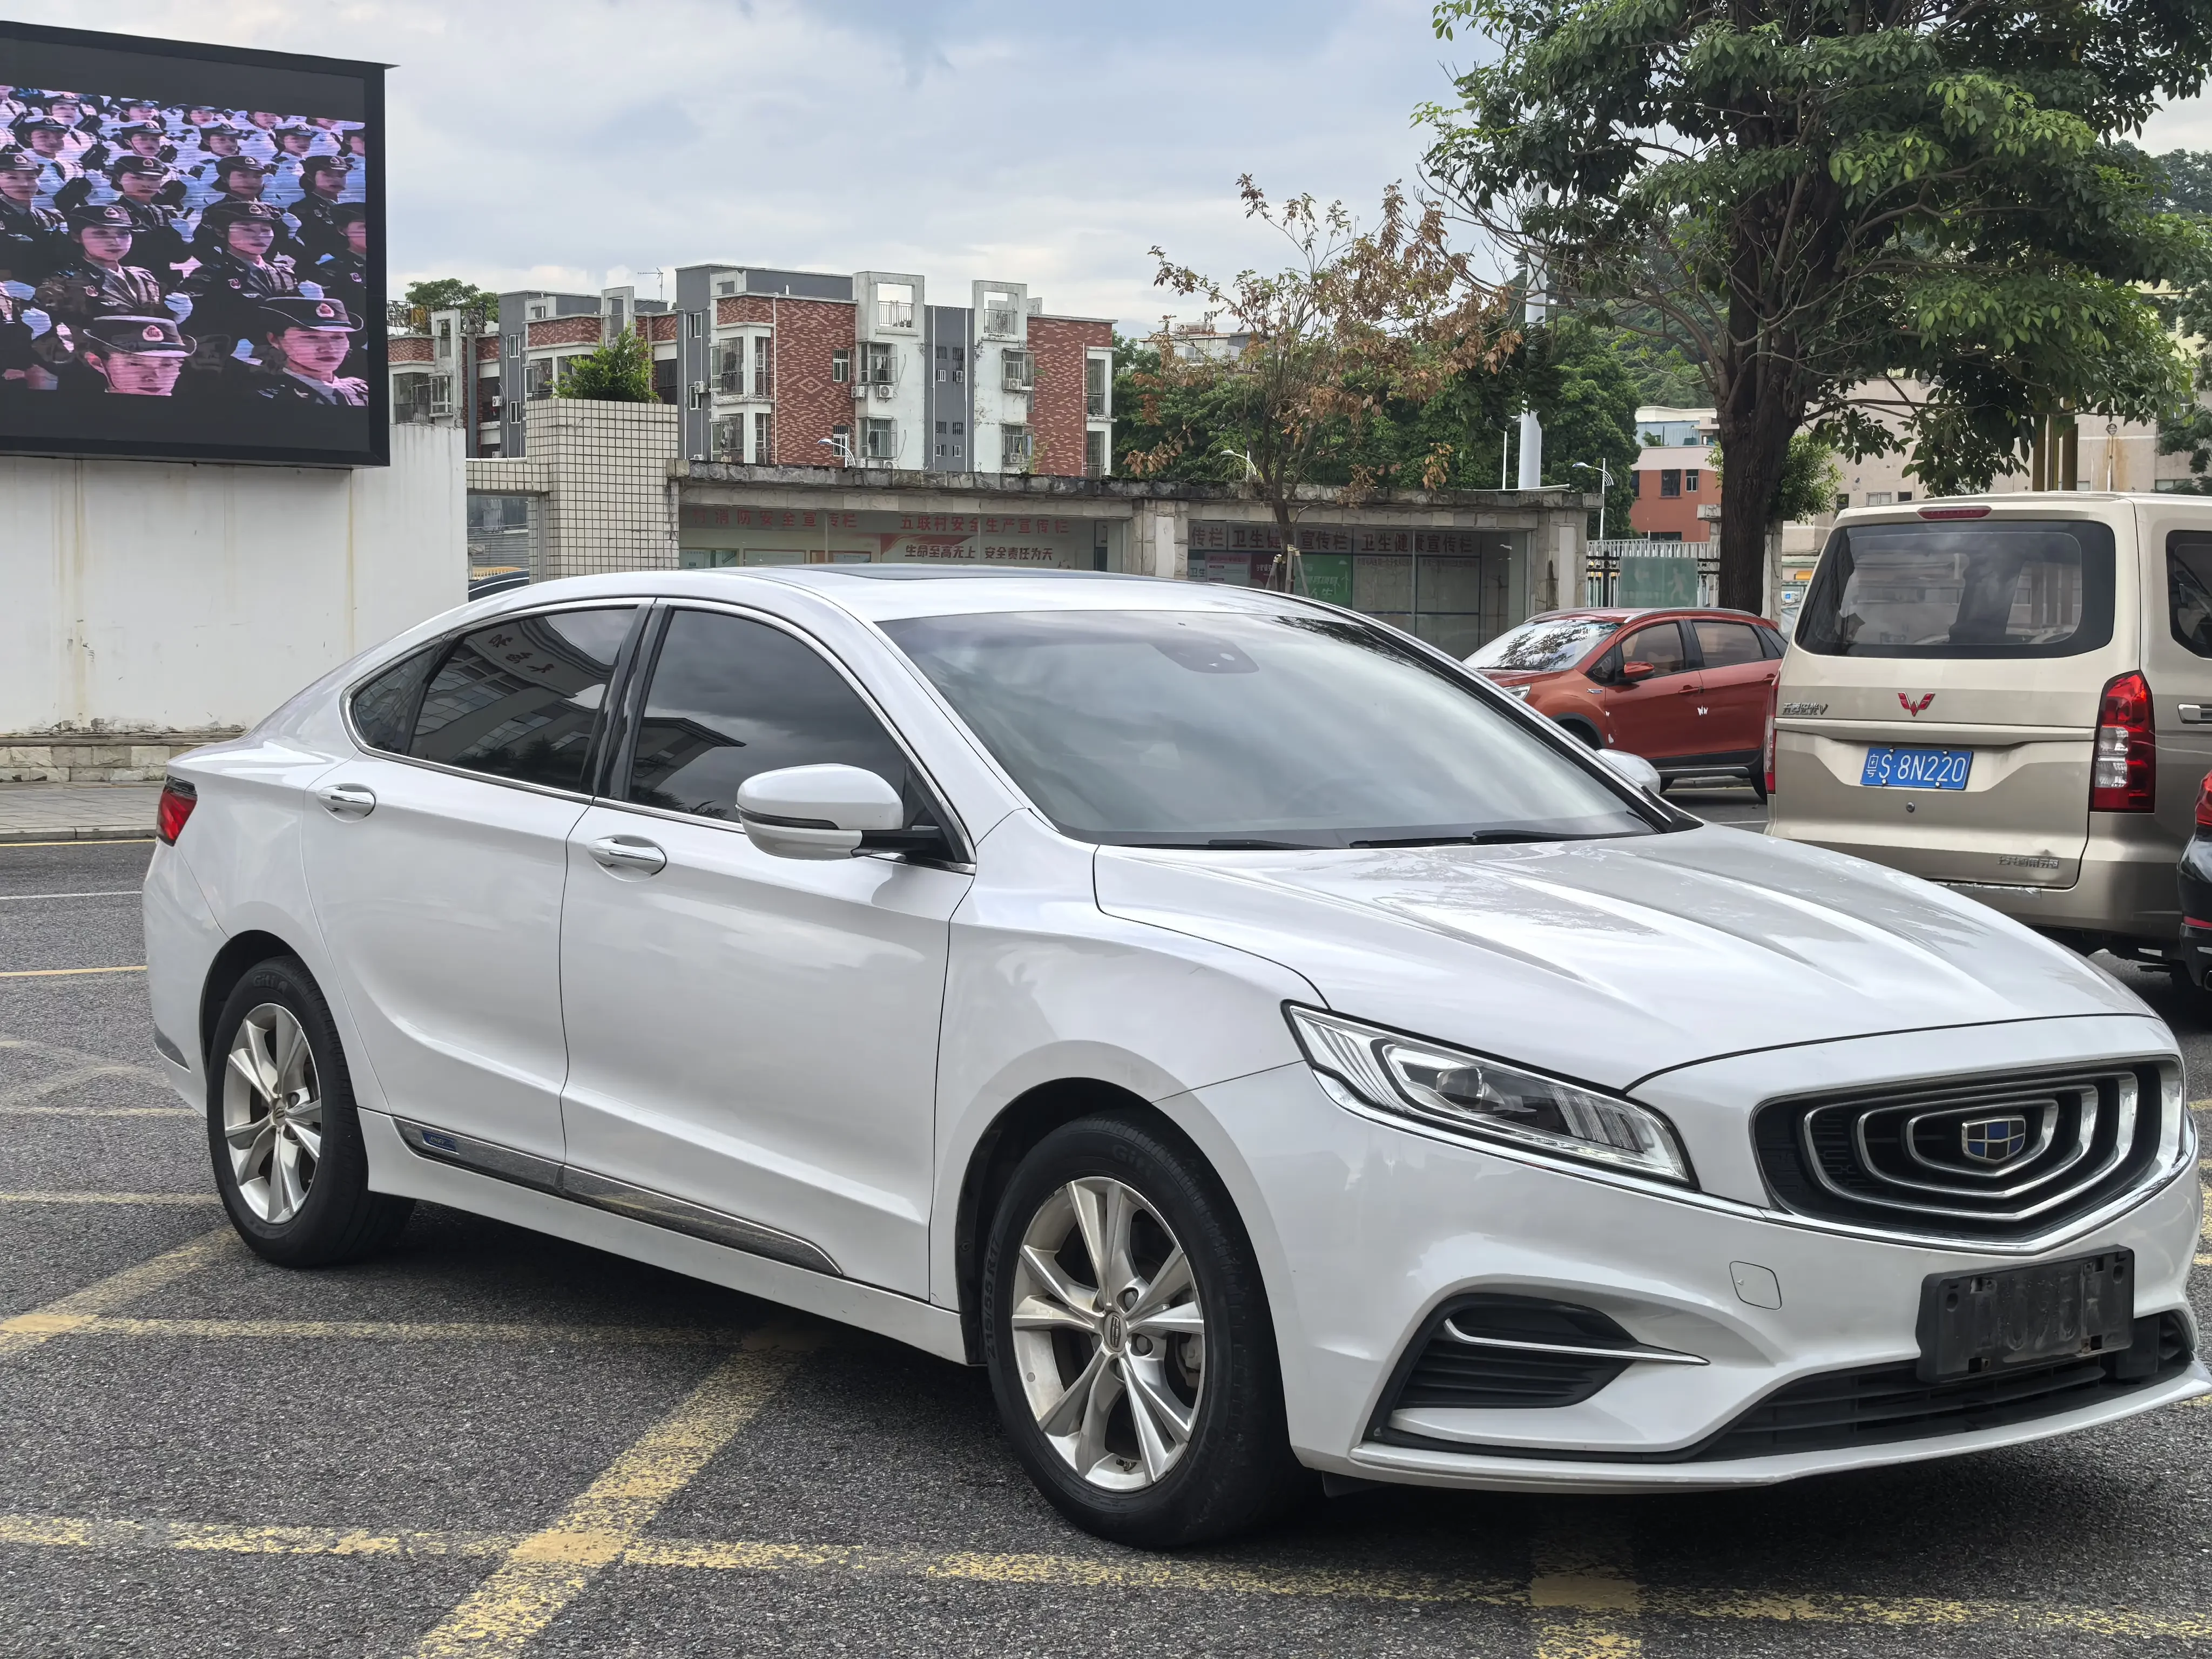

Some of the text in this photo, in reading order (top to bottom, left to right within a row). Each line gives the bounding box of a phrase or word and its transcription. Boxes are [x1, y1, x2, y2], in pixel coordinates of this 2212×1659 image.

[900, 515, 1069, 534] 五联村安全生产宣传栏
[1232, 530, 1348, 550] 卫生健宣传栏
[1361, 532, 1473, 553] 卫生健康宣传栏
[905, 544, 1053, 561] 生命至高无上 安全责任为天
